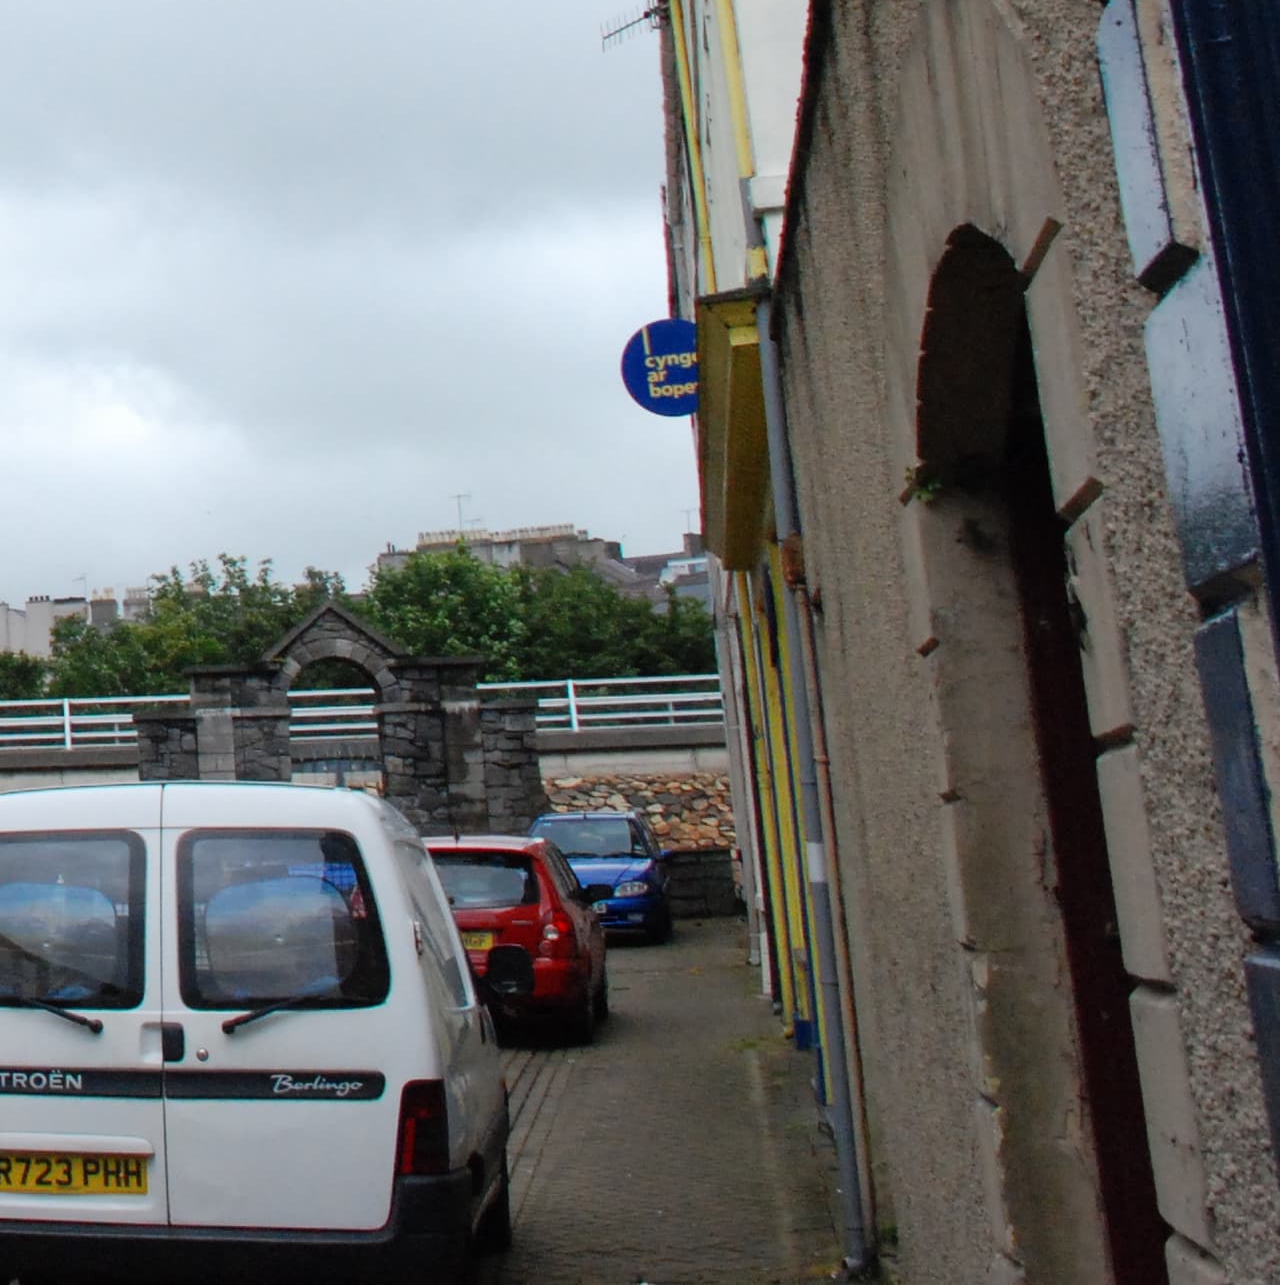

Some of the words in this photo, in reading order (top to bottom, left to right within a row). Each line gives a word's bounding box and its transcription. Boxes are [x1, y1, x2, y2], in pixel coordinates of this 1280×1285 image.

[647, 369, 668, 382] ar
[649, 381, 698, 399] bope
[270, 1074, 364, 1096] Berlingo
[82, 1159, 143, 1187] PHH
